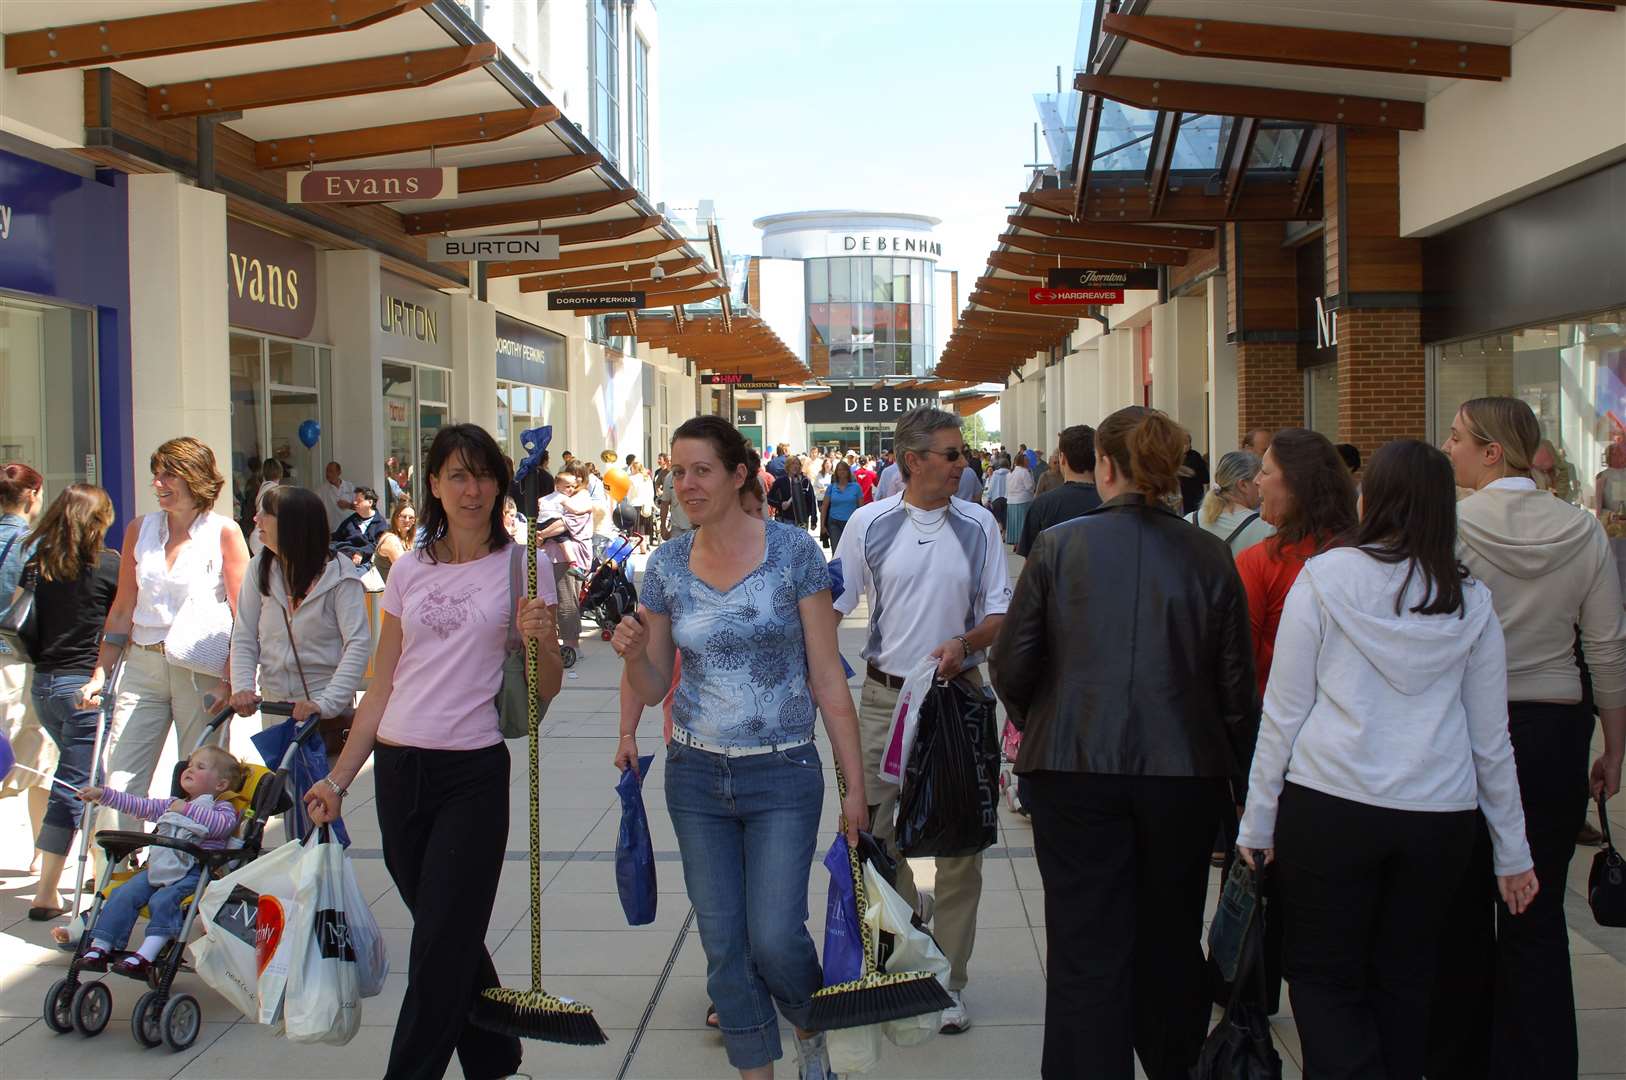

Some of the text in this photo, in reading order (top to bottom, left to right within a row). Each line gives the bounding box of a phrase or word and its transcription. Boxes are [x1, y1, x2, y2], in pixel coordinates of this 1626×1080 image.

[326, 176, 419, 196] Evans
[0, 205, 12, 240] y
[446, 240, 540, 255] BURTON
[230, 252, 298, 310] vans
[1080, 270, 1127, 284] Thorntons
[1057, 292, 1117, 300] HARGREAVES
[522, 344, 545, 365] PERKINS
[720, 375, 743, 384] HMV
